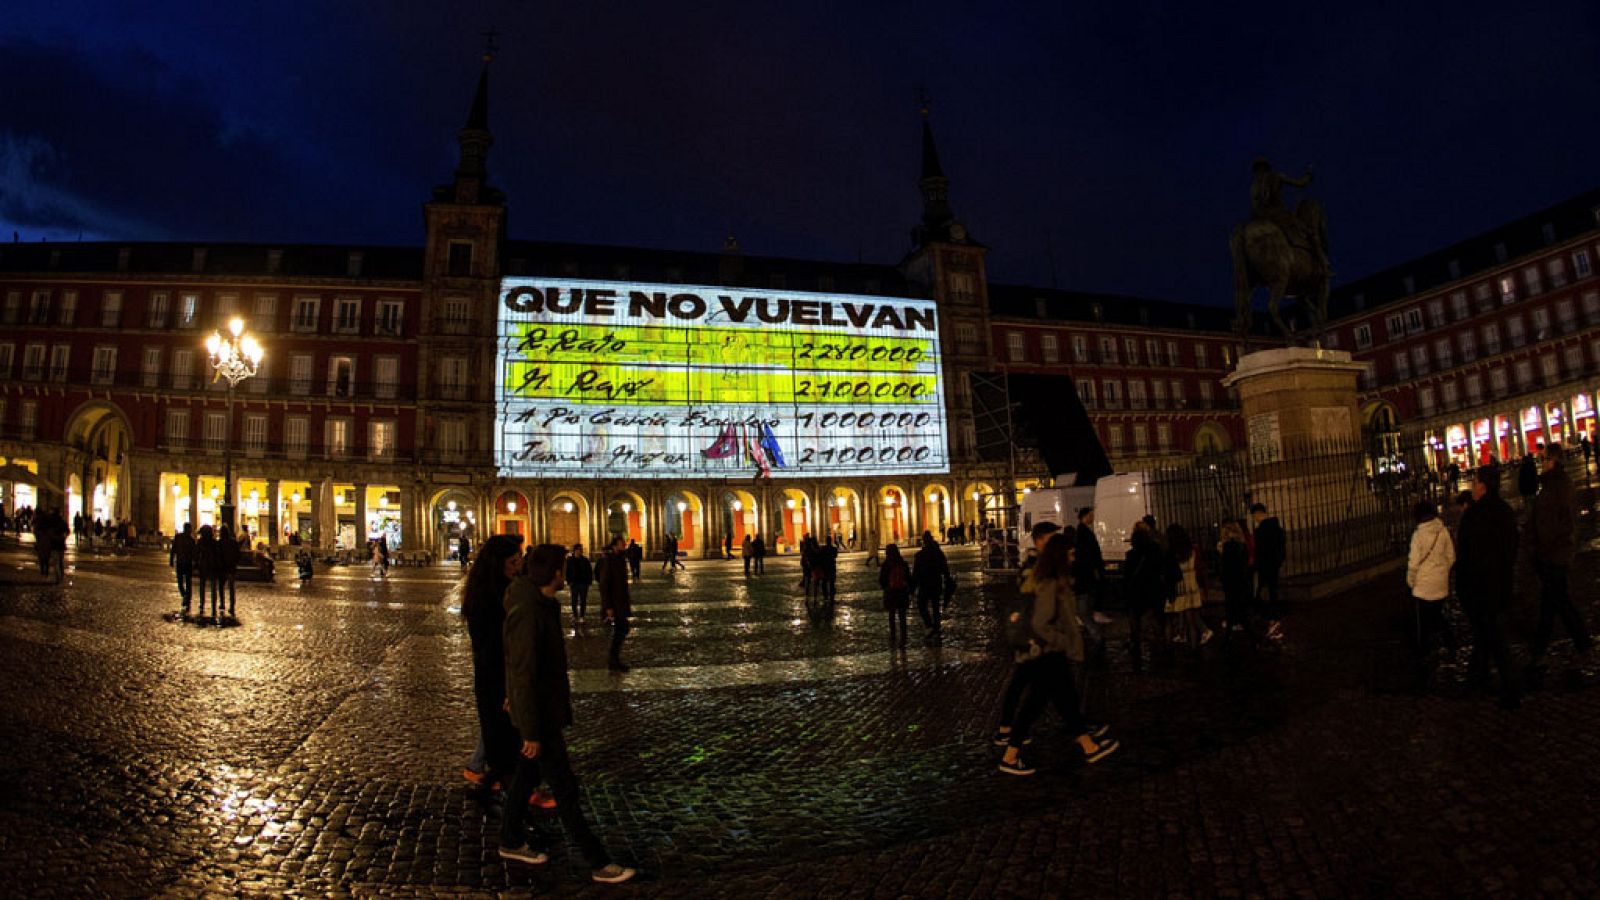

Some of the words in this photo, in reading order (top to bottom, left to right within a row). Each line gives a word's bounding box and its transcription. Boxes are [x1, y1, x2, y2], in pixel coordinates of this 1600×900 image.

[505, 286, 616, 314] QUE
[628, 291, 707, 320] NO
[717, 295, 937, 331] VUELVAN
